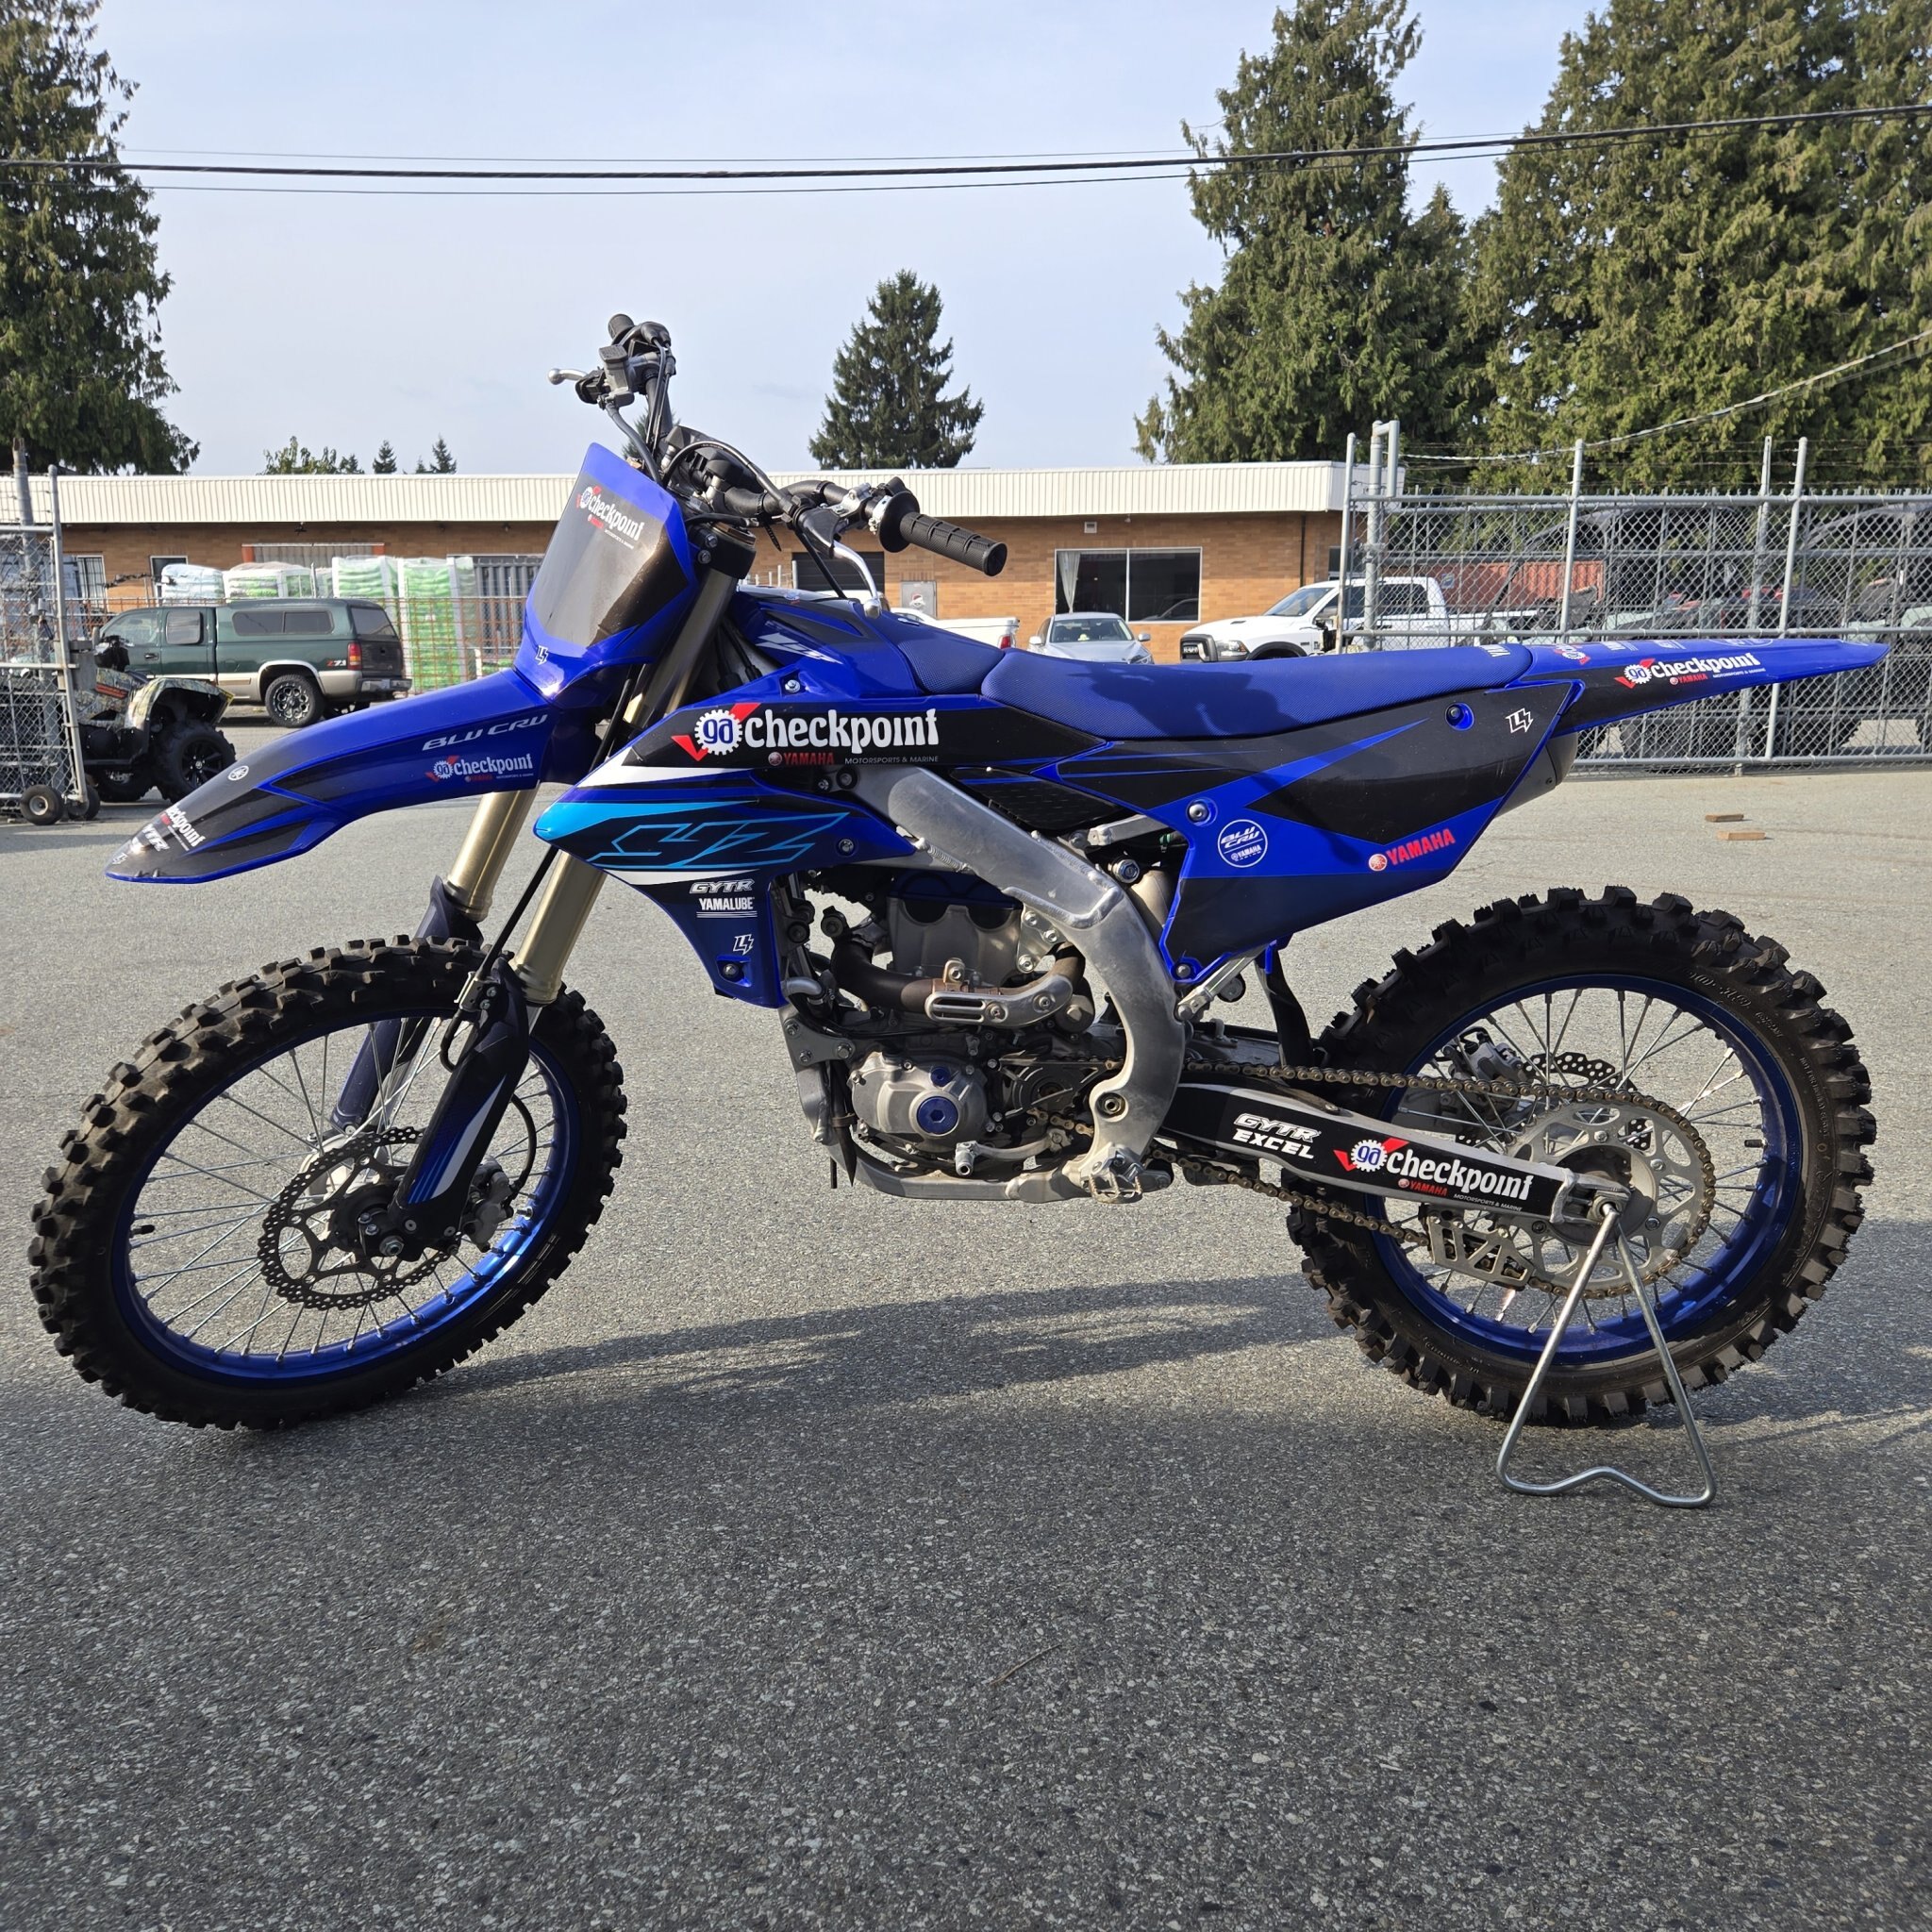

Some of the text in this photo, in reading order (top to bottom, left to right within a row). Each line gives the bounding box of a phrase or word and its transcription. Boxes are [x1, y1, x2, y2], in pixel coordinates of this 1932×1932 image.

[588, 493, 644, 541] checkpoint
[1651, 653, 1761, 678] checkpoint
[1678, 674, 1708, 684] YAMAHA
[422, 714, 548, 751] BLU CRU
[744, 708, 940, 754] checkpoint
[454, 754, 534, 775] checkpoint
[784, 752, 834, 765] YAMAHA
[1237, 844, 1261, 858] YAMAHA
[1386, 828, 1456, 865] YAMAHA
[690, 878, 755, 894] GYTR
[699, 896, 754, 911] YAMALUBE
[1234, 1113, 1321, 1143] GYTR
[1232, 1128, 1314, 1159] EXCEL
[1386, 1149, 1534, 1201] checkpoint
[1409, 1180, 1447, 1196] YAMAHA
[1453, 1193, 1495, 1207] MOTORSPORTS
[1500, 1203, 1523, 1212] MARINE
